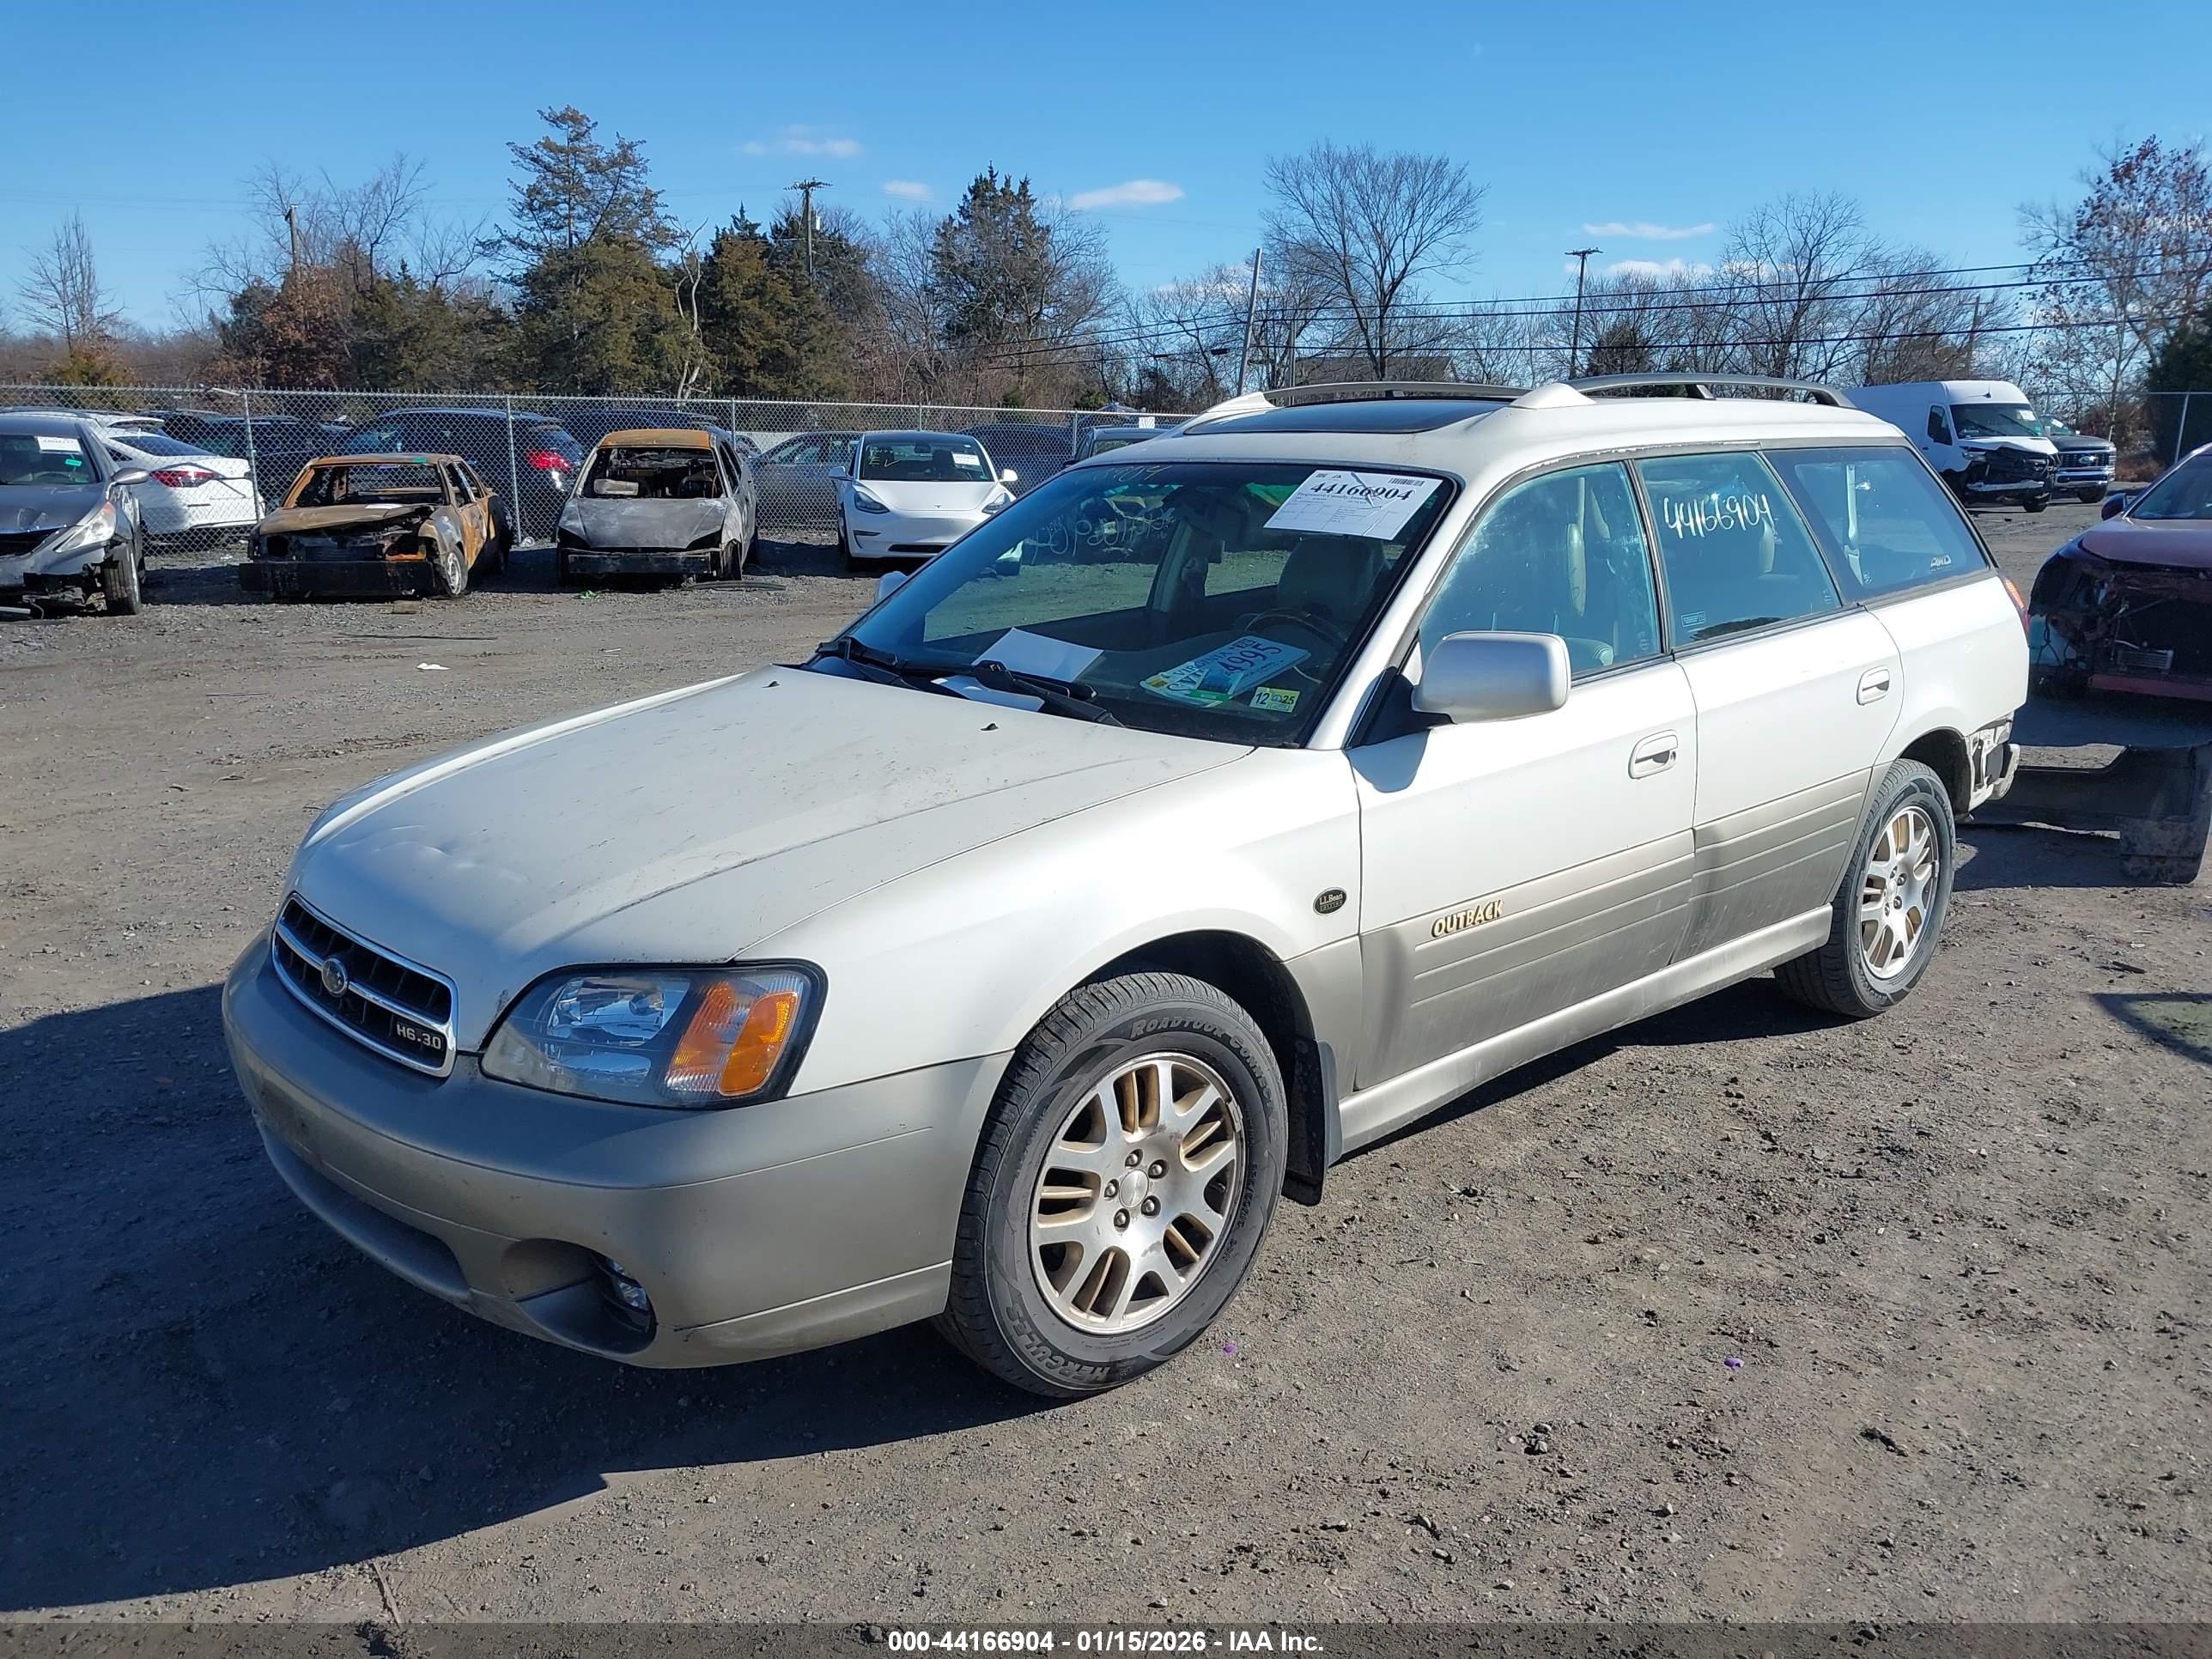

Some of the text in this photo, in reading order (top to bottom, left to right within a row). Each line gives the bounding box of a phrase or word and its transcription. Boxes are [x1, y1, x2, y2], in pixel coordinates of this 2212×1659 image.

[1310, 483, 1415, 501] 44166904
[1664, 493, 1778, 539] 44166904
[1174, 652, 1231, 676] VIRGINIA
[1218, 642, 1282, 674] 4995
[1256, 692, 1296, 705] 12 25
[1431, 899, 1504, 938] OUTBACK
[1006, 1304, 1111, 1382] HERCULES
